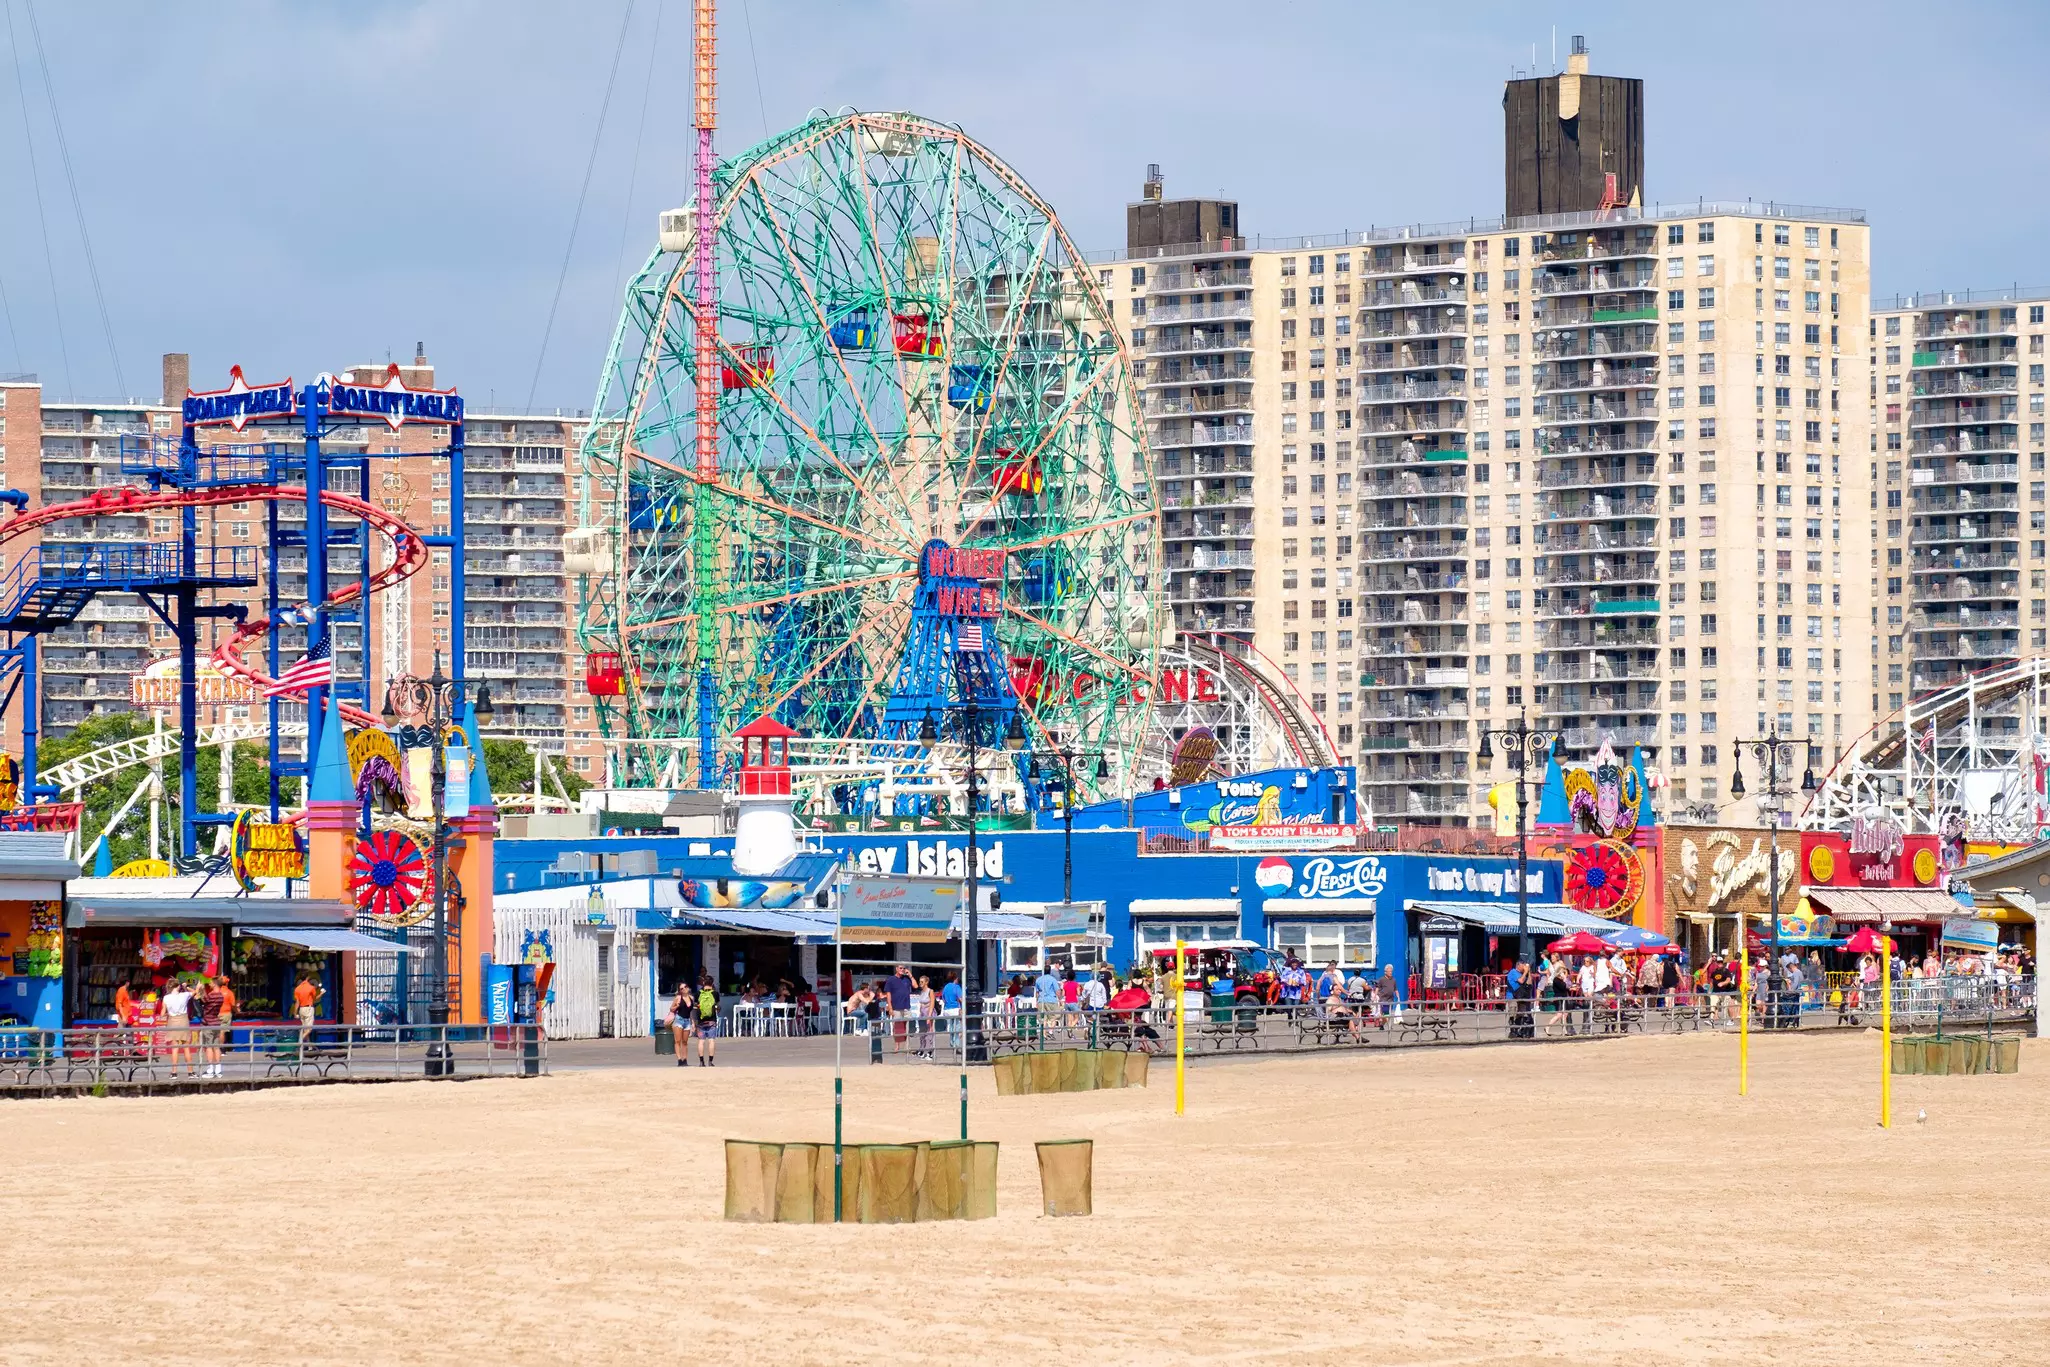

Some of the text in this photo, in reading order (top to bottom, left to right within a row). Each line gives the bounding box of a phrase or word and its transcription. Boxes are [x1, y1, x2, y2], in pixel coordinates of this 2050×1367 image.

[244, 386, 292, 414] EAGLE
[401, 392, 460, 421] EAGLE
[928, 547, 1004, 578] WONDER
[937, 586, 1003, 618] WHEEL
[134, 677, 251, 701] STEEPCHASE
[1217, 780, 1264, 797] Tom's
[1222, 800, 1259, 822] Coney
[1282, 808, 1327, 825] Island
[1226, 826, 1339, 836] TOM'S CONEY ISLAND
[1851, 817, 1904, 864] Ruby's
[907, 840, 1003, 879] Island
[1428, 867, 1464, 891] Tom's
[1465, 868, 1503, 897] Coney
